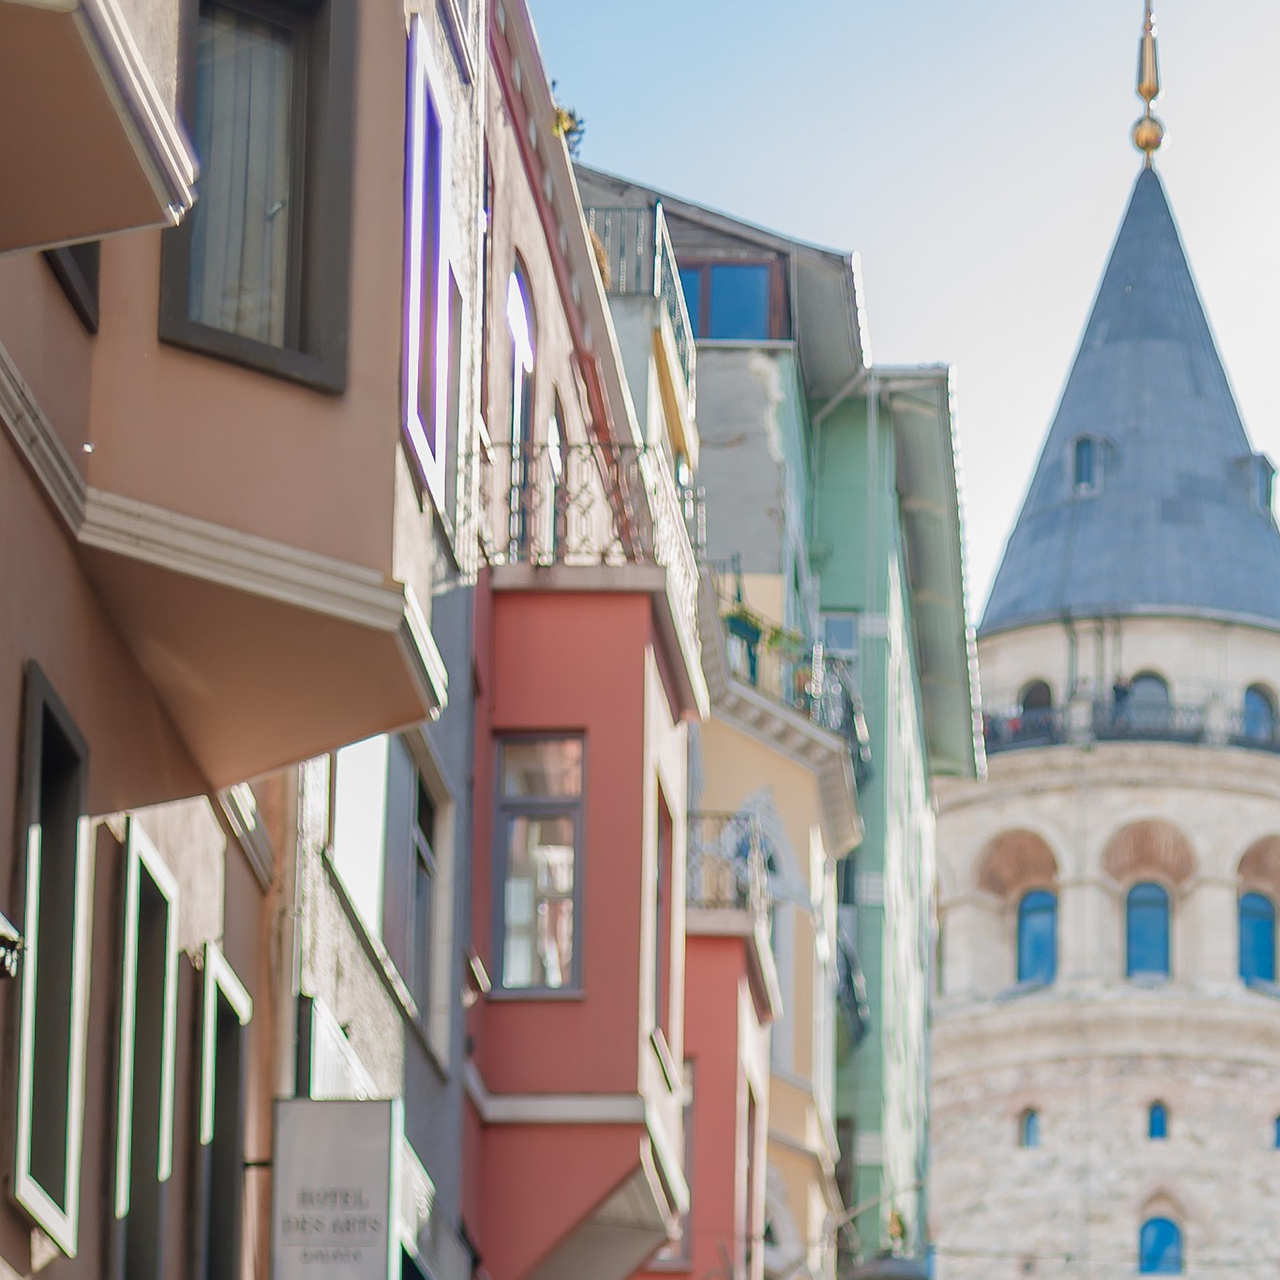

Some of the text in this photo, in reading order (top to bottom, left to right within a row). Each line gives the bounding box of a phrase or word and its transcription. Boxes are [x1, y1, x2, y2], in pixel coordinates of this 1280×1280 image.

[297, 1187, 369, 1210] HOTEL
[282, 1214, 382, 1236] DES ARTS
